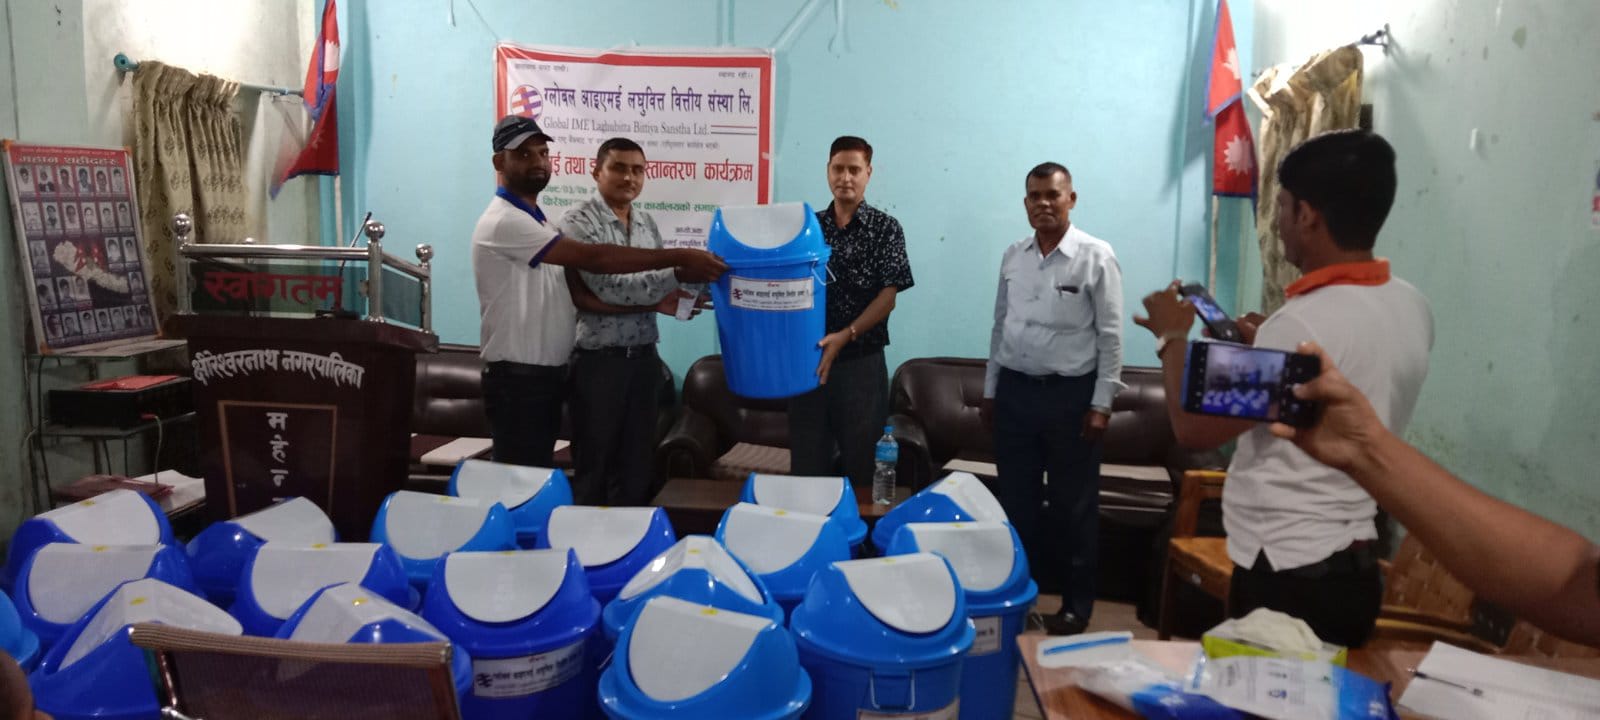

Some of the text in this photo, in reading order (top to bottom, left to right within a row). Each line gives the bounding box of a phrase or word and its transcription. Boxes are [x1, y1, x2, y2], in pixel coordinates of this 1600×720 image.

[544, 81, 576, 107] ग्लोबल
[581, 85, 622, 112] आइएमई
[628, 86, 665, 116] लघुवित्त
[671, 86, 702, 112] वित्तीय
[707, 89, 734, 113] संस्था
[543, 116, 570, 130] Global
[571, 117, 590, 131] IME
[592, 119, 631, 135] Laghubitta
[661, 122, 691, 135] Sanstha
[693, 122, 709, 136] Ltd.
[564, 156, 586, 175] तथा
[644, 158, 753, 182] स्तान्तरण कार्यक्रम
[281, 349, 365, 389] नगरपालिका
